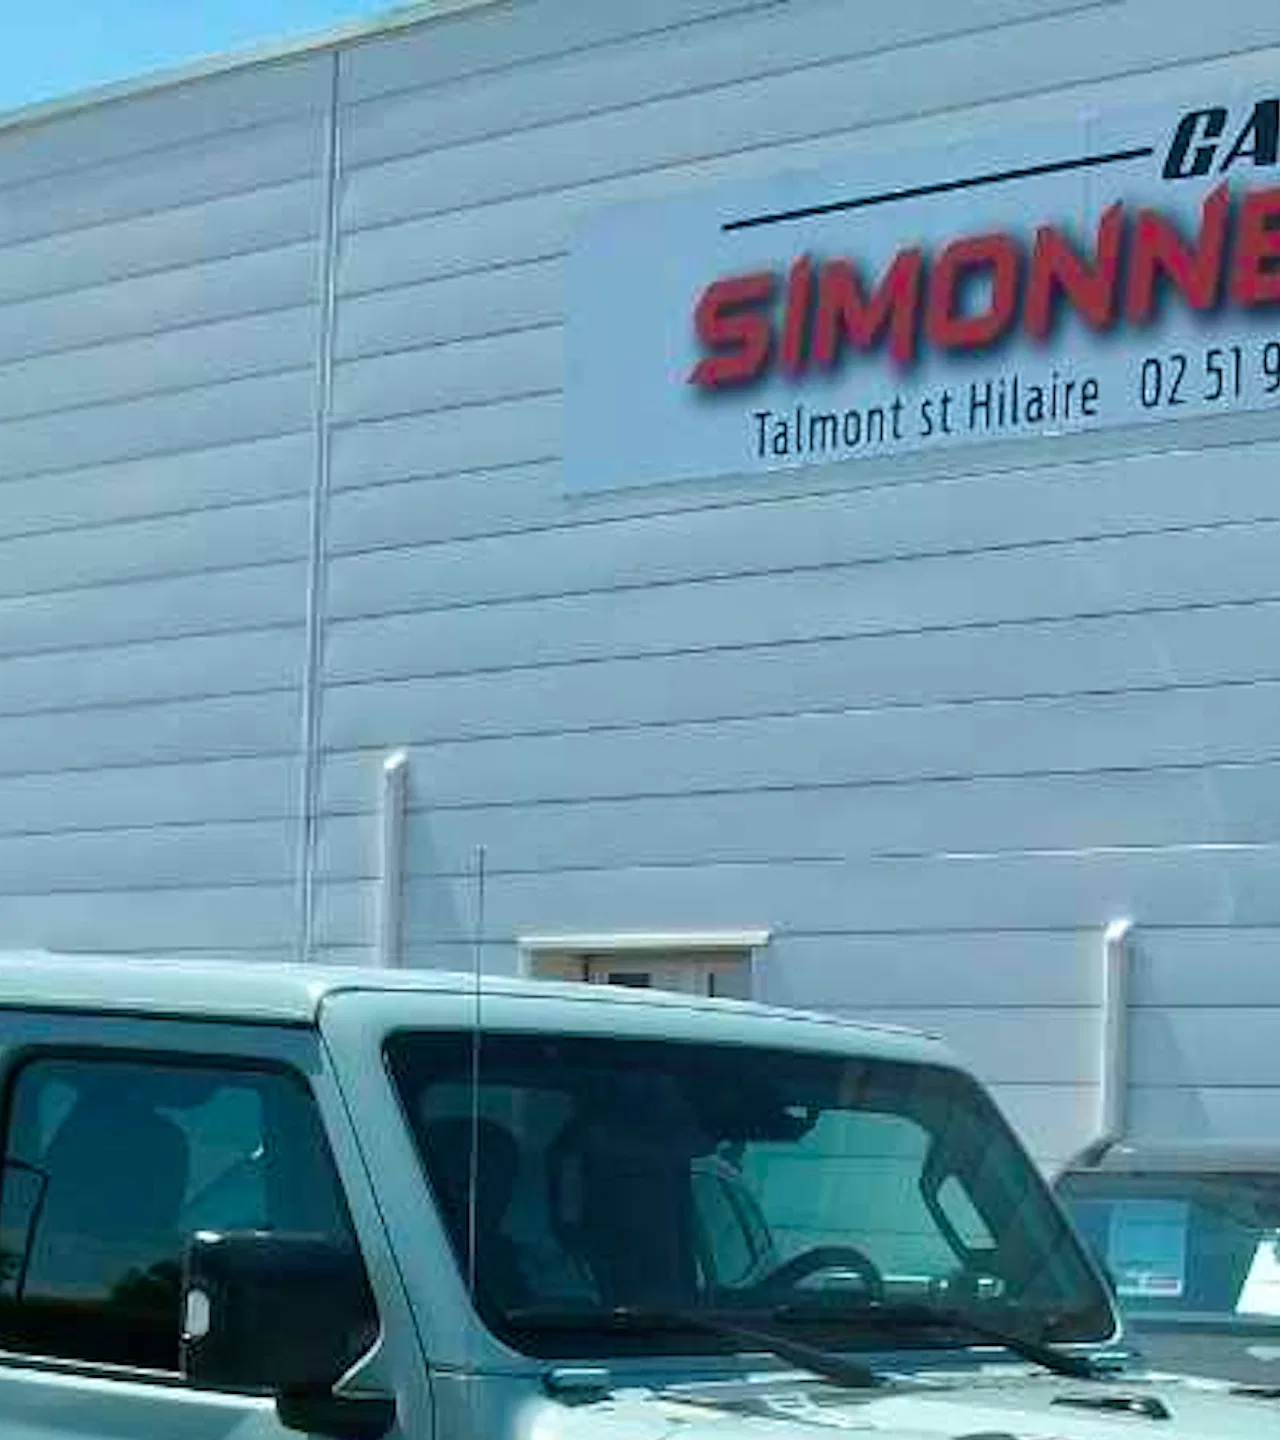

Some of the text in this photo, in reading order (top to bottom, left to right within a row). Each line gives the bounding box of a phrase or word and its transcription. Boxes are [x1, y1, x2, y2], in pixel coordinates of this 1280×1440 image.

[753, 403, 904, 457] Talmont
[918, 396, 952, 435] st
[968, 371, 1099, 428] Hilaire
[1140, 355, 1190, 408] 02
[1204, 346, 1243, 400] 51
